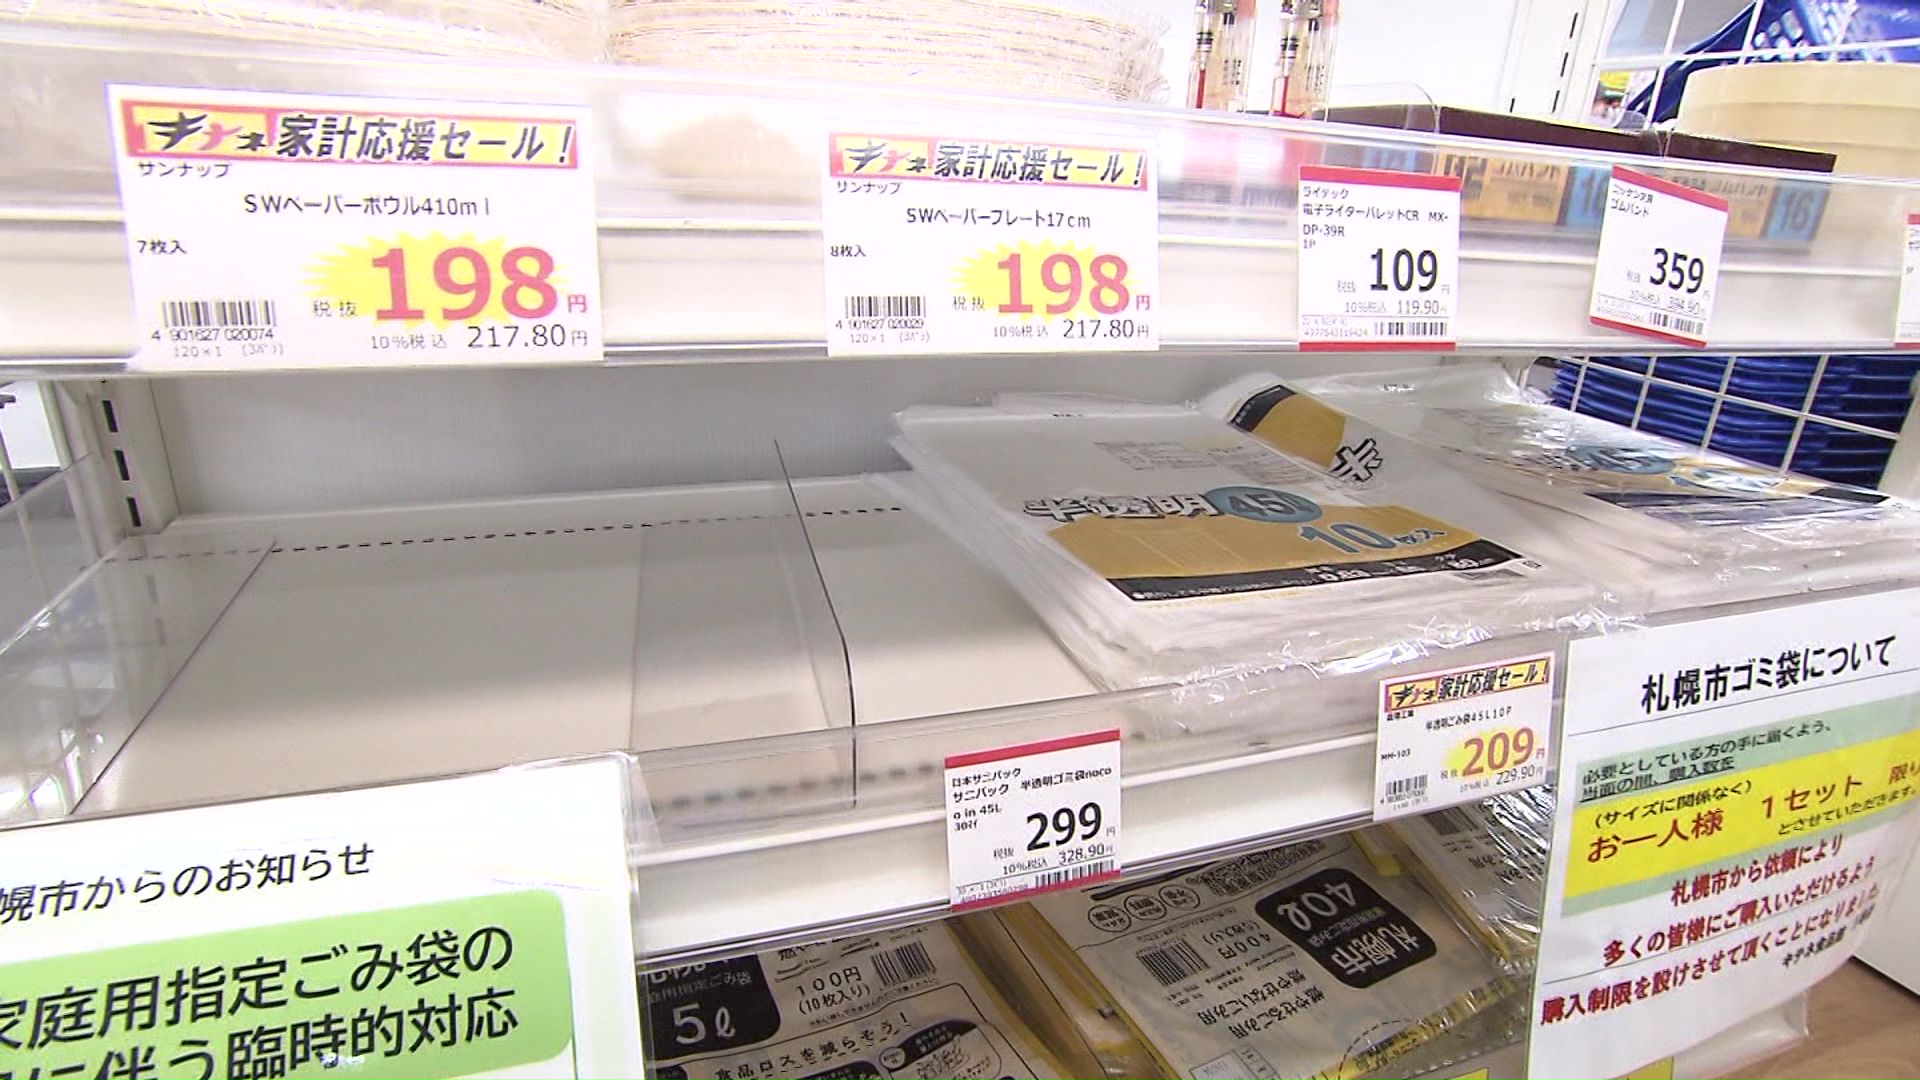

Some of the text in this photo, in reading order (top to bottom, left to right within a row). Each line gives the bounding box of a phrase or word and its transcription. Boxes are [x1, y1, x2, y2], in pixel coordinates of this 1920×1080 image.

[138, 161, 230, 178] サンナップ
[136, 239, 188, 255] 7枚入
[1641, 634, 1896, 715] 札幌市ゴミ袋について
[964, 805, 977, 818] in
[1587, 807, 1724, 864] お一人様
[1670, 833, 1845, 908] 札幌市から依頼により
[1602, 855, 1877, 969] 多くの皆様にご購入いただけるよう
[1329, 921, 1421, 976] 札幌市
